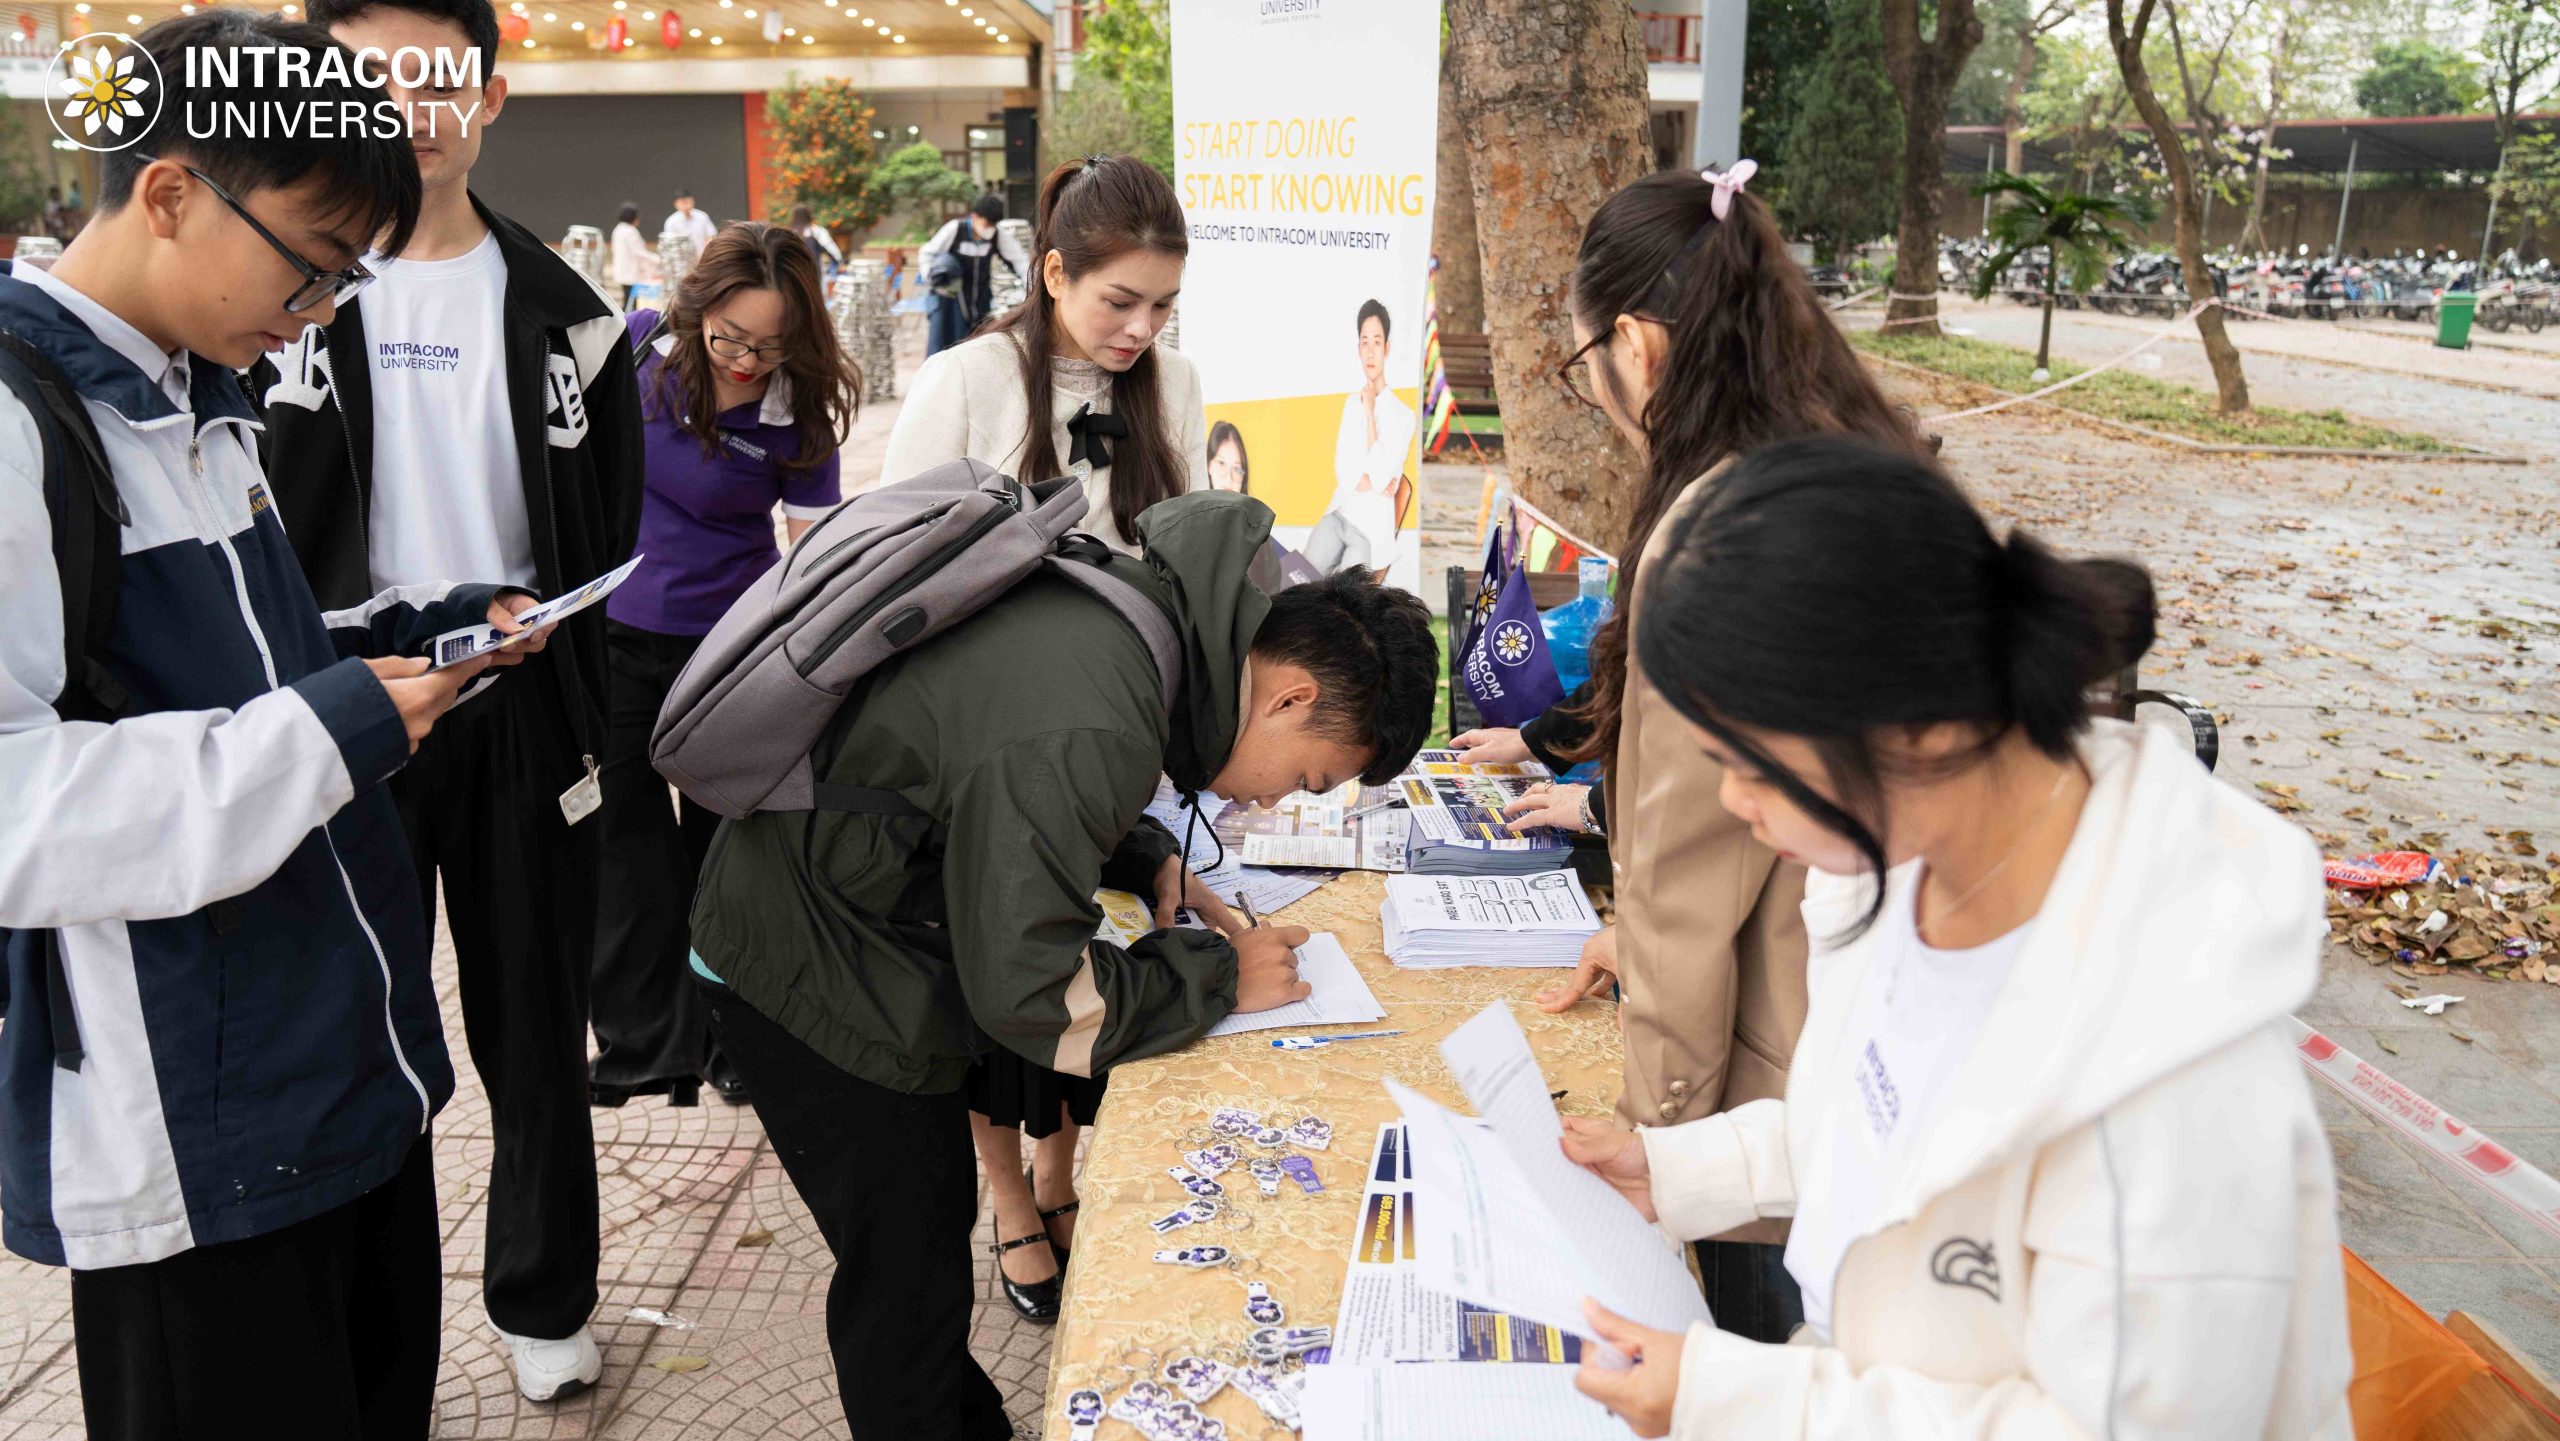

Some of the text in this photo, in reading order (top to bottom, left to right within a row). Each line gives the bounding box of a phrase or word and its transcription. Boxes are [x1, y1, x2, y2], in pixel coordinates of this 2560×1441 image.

[1183, 116, 1357, 160] START DOING
[1184, 174, 1424, 216] START KNOWING
[1239, 226, 1254, 242] TO
[1257, 227, 1317, 246] INTRACOM
[1320, 231, 1390, 250] UNIVERSITY
[379, 342, 459, 359] INTRACOM
[380, 357, 458, 372] UNIVERSITY
[1468, 649, 1492, 701] ERSITY
[1476, 628, 1505, 699] TRACOM
